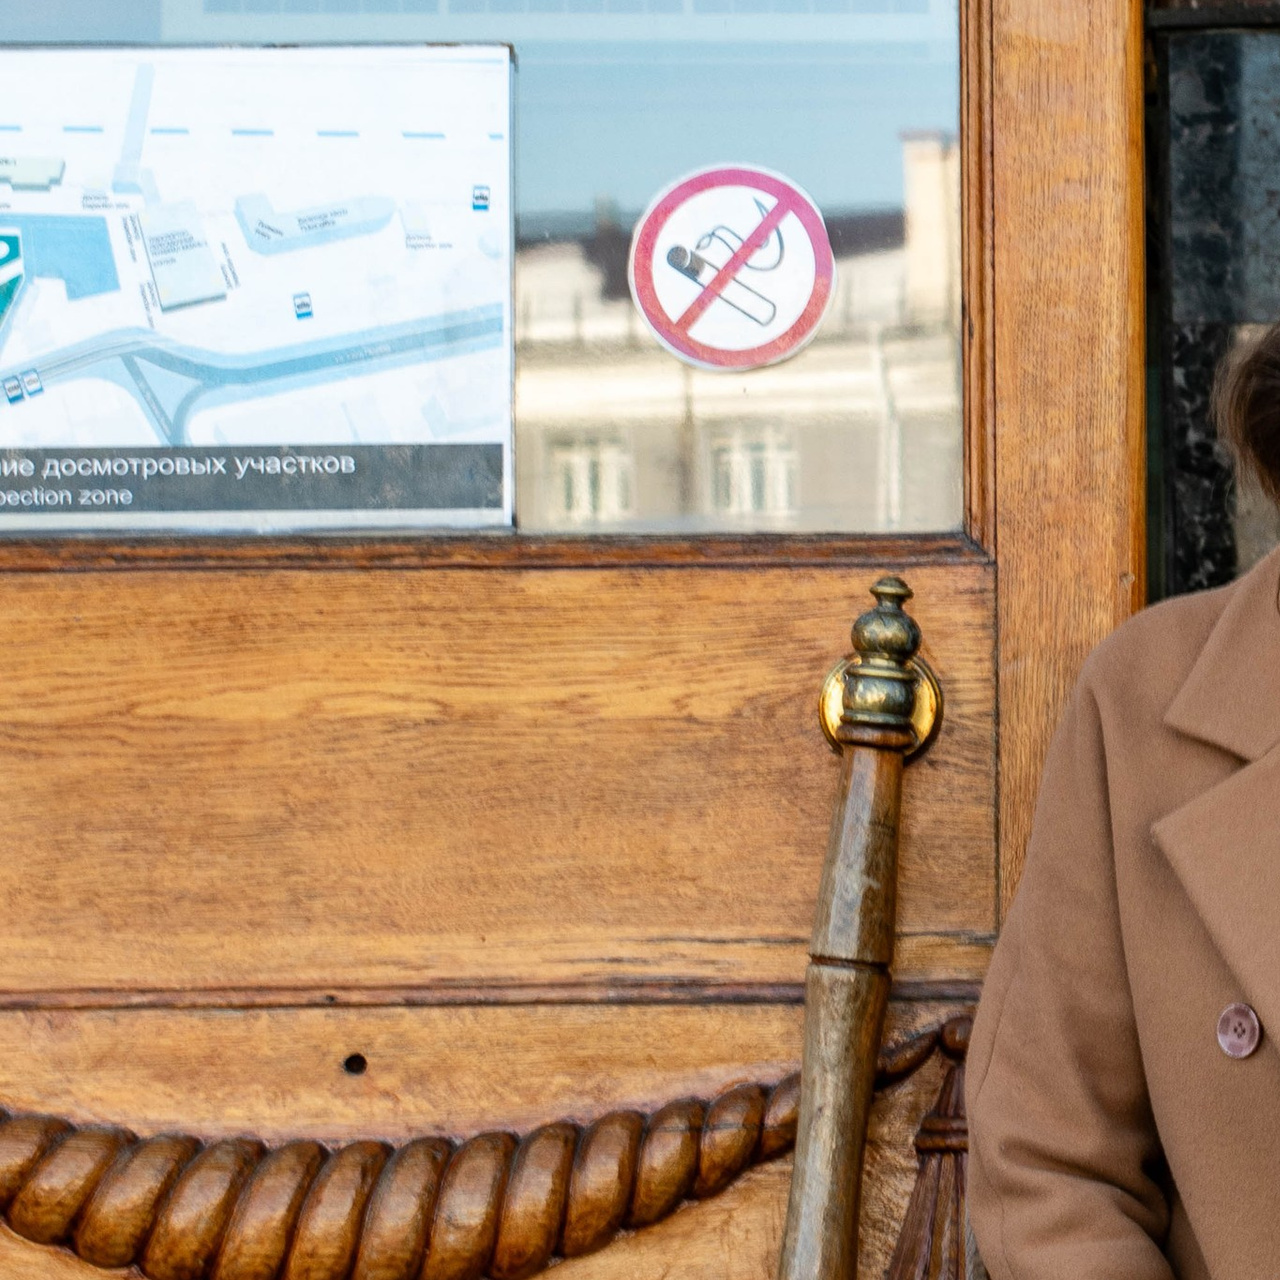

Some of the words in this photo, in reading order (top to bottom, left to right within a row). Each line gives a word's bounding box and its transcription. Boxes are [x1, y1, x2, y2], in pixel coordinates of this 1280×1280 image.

[0, 458, 35, 477] ие
[41, 456, 227, 481] досмотровых
[234, 454, 356, 480] участков
[78, 488, 133, 506] zone
